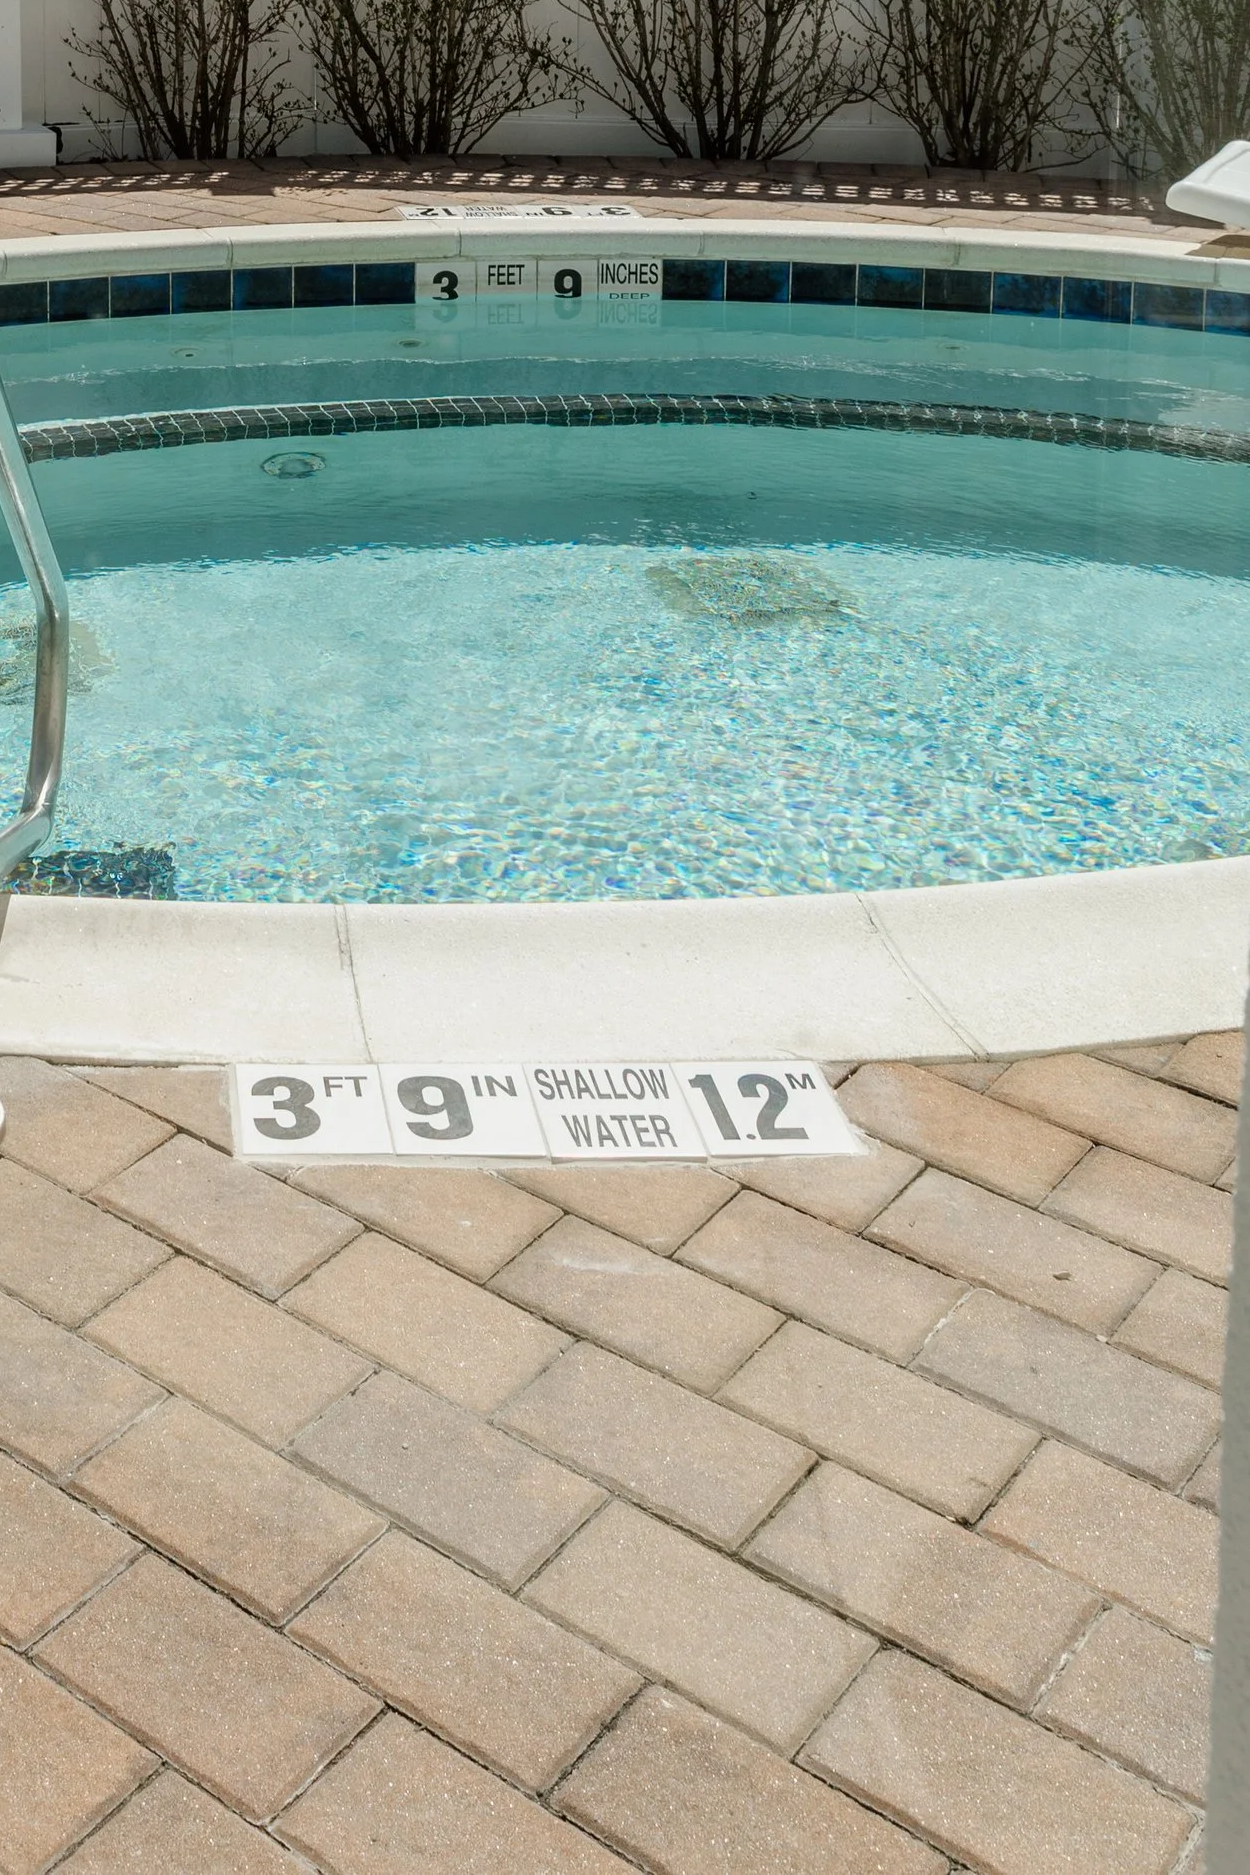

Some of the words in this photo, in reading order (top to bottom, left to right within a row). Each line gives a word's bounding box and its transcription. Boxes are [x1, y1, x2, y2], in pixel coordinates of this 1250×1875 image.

[541, 206, 573, 216] 9
[601, 207, 631, 216] 3
[432, 270, 459, 301] 3
[488, 264, 525, 285] FEET
[553, 269, 582, 298] 9
[601, 263, 659, 285] INCHES
[609, 292, 650, 300] DEEP
[534, 1068, 670, 1101] SHALLOW
[251, 1076, 321, 1141] 3
[323, 1075, 367, 1098] FT
[397, 1075, 474, 1141] 9
[472, 1075, 517, 1098] IN
[687, 1073, 809, 1141] 1.2
[785, 1072, 816, 1090] M
[562, 1114, 678, 1149] WATER
